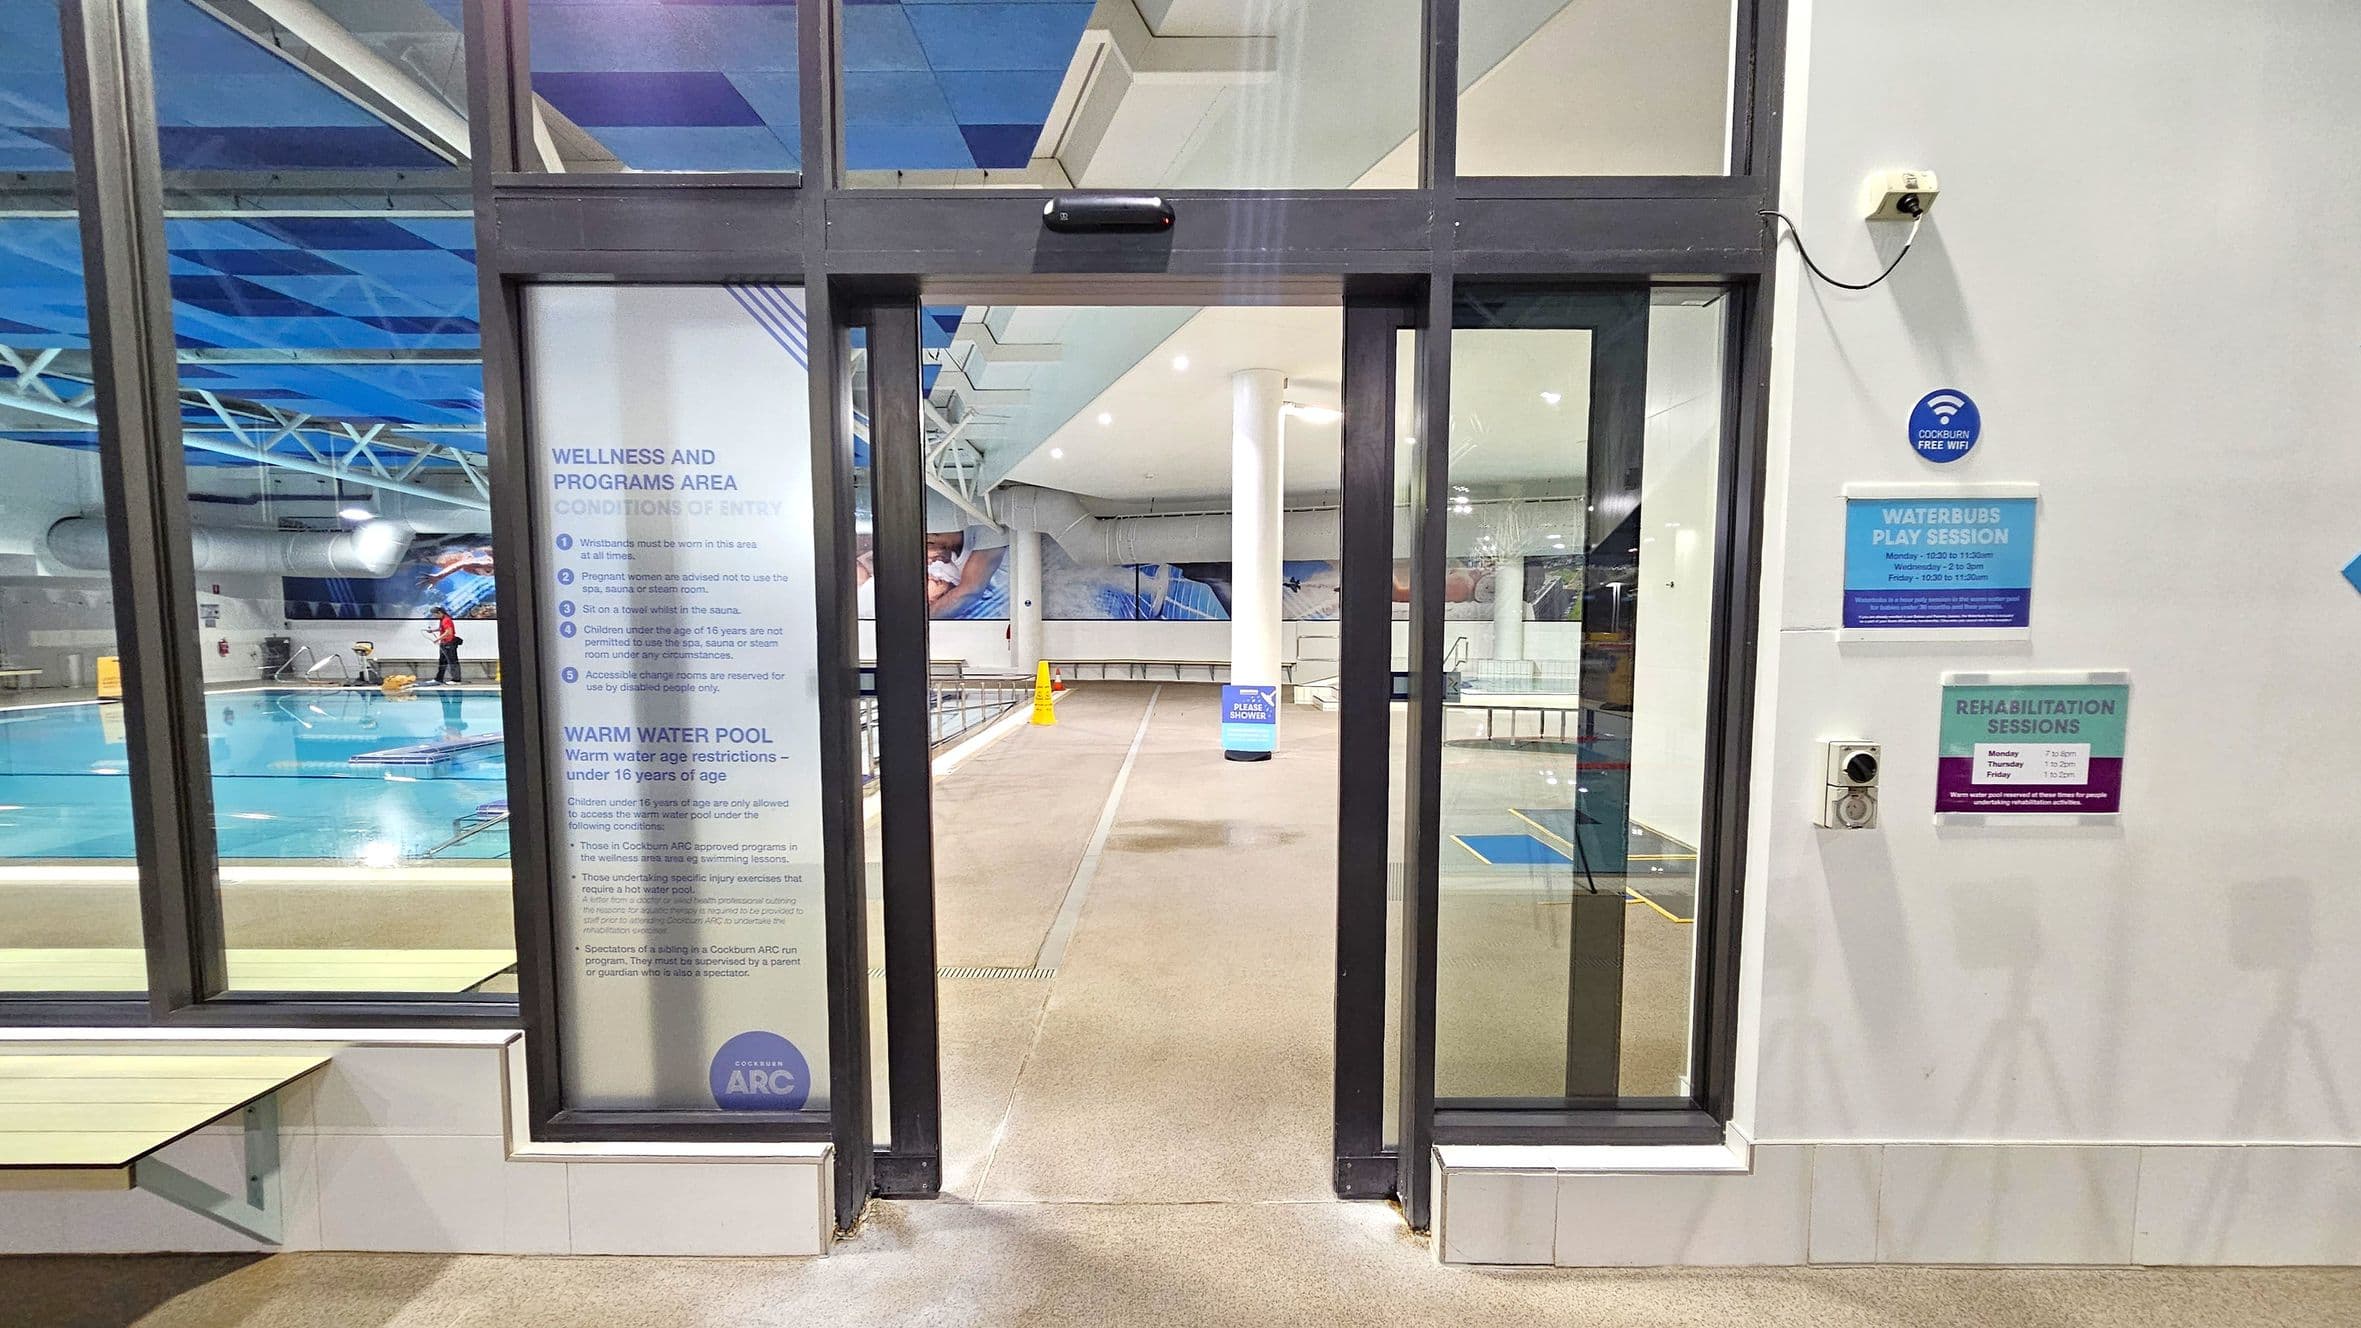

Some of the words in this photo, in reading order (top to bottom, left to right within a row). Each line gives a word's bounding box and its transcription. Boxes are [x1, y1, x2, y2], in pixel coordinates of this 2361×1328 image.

[1918, 430, 1970, 439] COCKBURN
[1918, 441, 1944, 450] FREE
[1947, 441, 1969, 450] WIFI
[552, 448, 665, 464] WELLNESS
[671, 450, 716, 465] AND
[554, 474, 674, 490] PROGRAMS
[680, 475, 738, 490] AREA
[554, 500, 681, 516] CONDITIONS
[688, 501, 713, 516] OF
[720, 502, 782, 516] ENTRY
[1882, 508, 2000, 524] WATERBUBS
[580, 538, 634, 548] Wristbands
[637, 539, 661, 548] must
[664, 538, 675, 548] be
[704, 539, 714, 548] in
[716, 539, 734, 548] this
[1872, 530, 1921, 545] PLAY
[1927, 529, 2008, 545] SESSION
[580, 552, 590, 560] at
[593, 551, 604, 560] all
[606, 551, 636, 560] times.
[581, 572, 625, 584] Pregnant
[682, 573, 720, 582] advised
[722, 574, 738, 582] not
[740, 574, 750, 582] to
[773, 573, 789, 582] the
[582, 586, 603, 596] spa,
[649, 585, 678, 593] steam
[582, 604, 596, 614] Sit
[622, 605, 648, 614] towel
[650, 605, 677, 614] whilst
[680, 605, 688, 614] in
[690, 605, 707, 614] the
[583, 625, 623, 635] Children
[626, 625, 654, 635] under
[656, 625, 671, 635] the
[674, 627, 692, 637] age
[694, 626, 704, 635] of
[706, 626, 718, 635] 16
[720, 628, 747, 638] years
[767, 627, 784, 635] not
[584, 638, 630, 649] permitted
[632, 638, 642, 647] to
[664, 638, 680, 647] the
[682, 640, 702, 650] spa,
[750, 639, 779, 647] steam
[612, 650, 640, 659] under
[642, 652, 660, 661] any
[662, 650, 734, 659] circumstances.
[585, 671, 637, 680] Accessible
[640, 671, 673, 682] change
[728, 671, 769, 680] reserved
[772, 671, 786, 681] for
[606, 683, 617, 694] by
[620, 683, 660, 692] disabled
[663, 683, 695, 694] people
[698, 683, 720, 694] only.
[1234, 703, 1262, 711] PLEASE
[1956, 700, 2115, 715] REHABILITATION
[1230, 711, 1266, 719] SHOWER
[1987, 719, 2080, 734] SESSIONS
[564, 726, 631, 742] WARM
[636, 727, 709, 743] WATER
[716, 728, 773, 743] POOL
[565, 749, 609, 762] Warm
[613, 750, 656, 762] water
[660, 752, 688, 765] age
[692, 750, 776, 762] restrictions
[566, 769, 610, 781] under
[614, 769, 631, 781] 16
[635, 771, 676, 784] years
[680, 769, 696, 781] of
[700, 772, 728, 784] age
[568, 821, 611, 833] following
[613, 822, 666, 831] conditions:
[584, 945, 635, 956] Spectators
[638, 945, 647, 954] of
[658, 945, 688, 956] sibling
[690, 945, 699, 954] in
[710, 945, 755, 954] Cockburn
[758, 945, 779, 954] ARC
[726, 1070, 795, 1095] ARC
